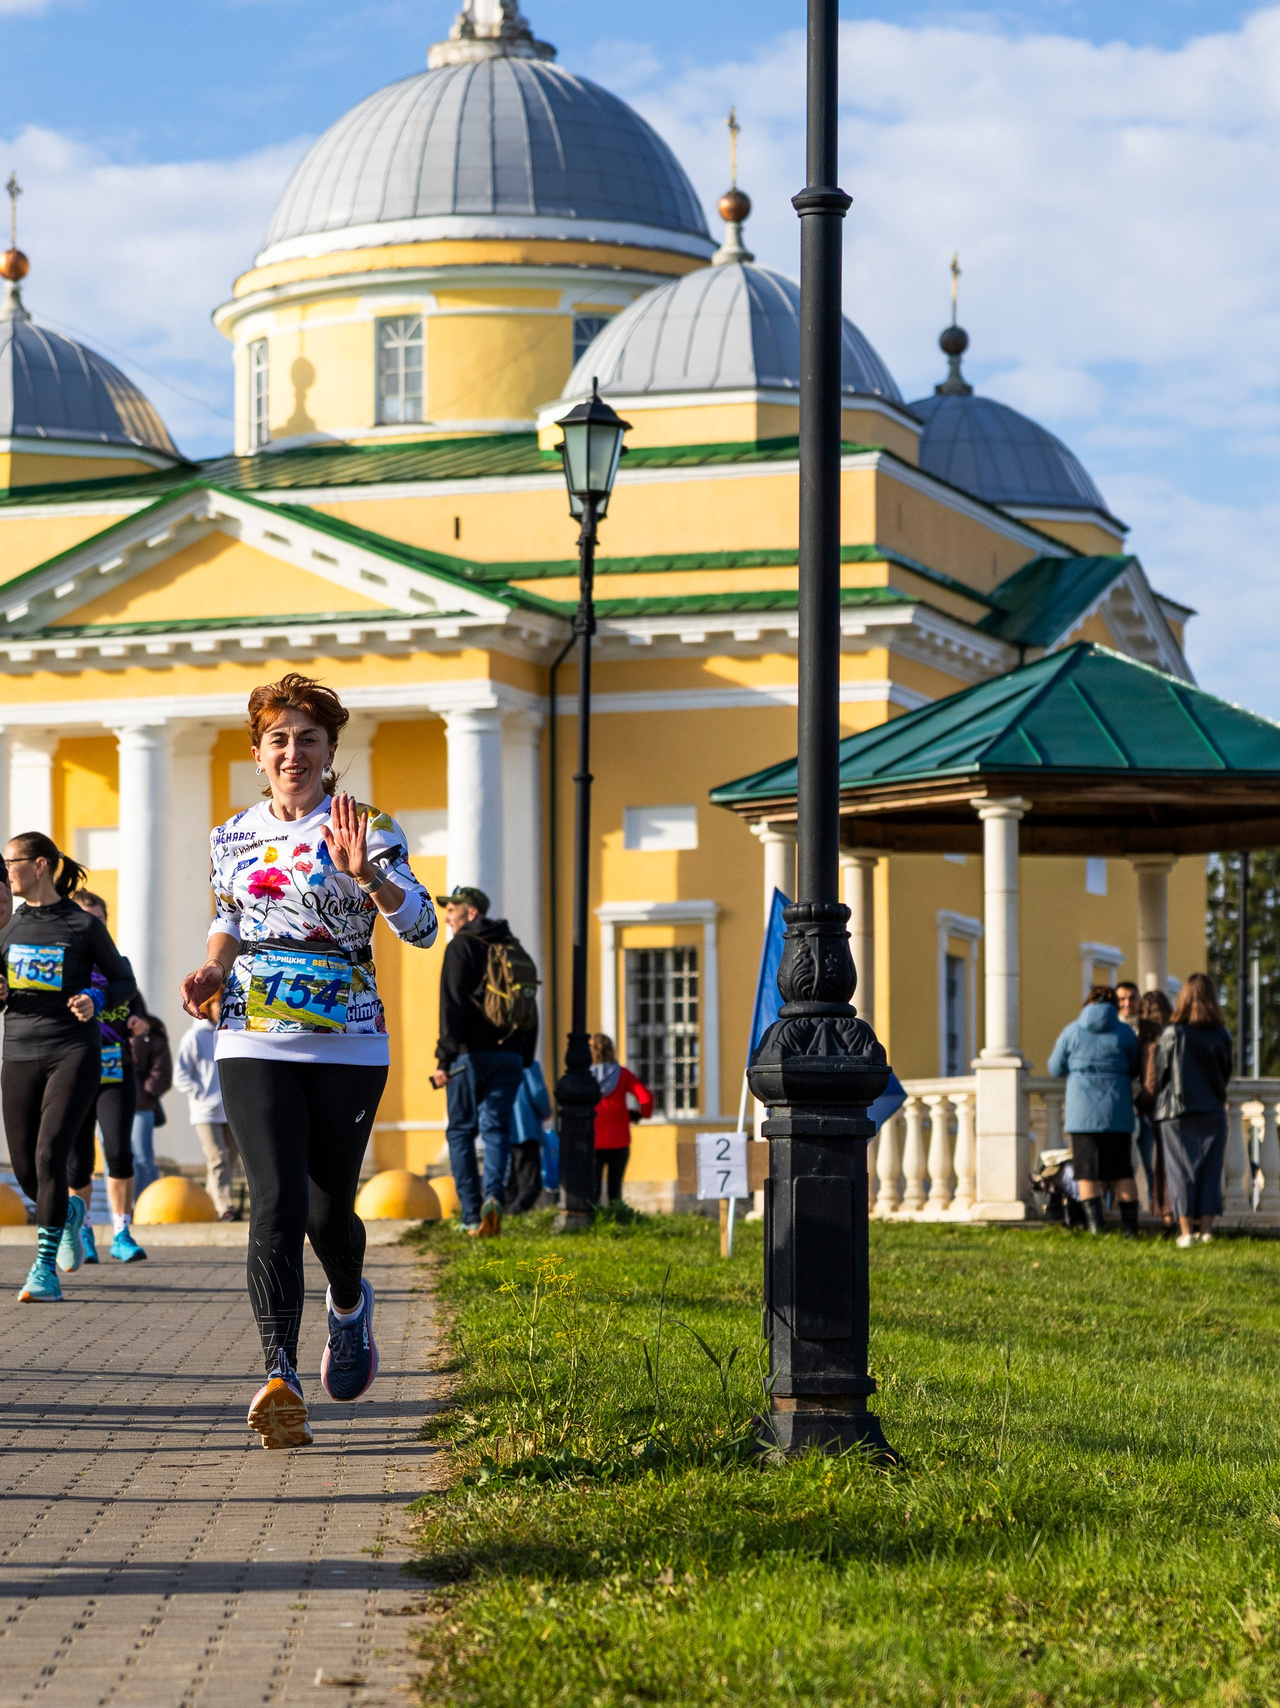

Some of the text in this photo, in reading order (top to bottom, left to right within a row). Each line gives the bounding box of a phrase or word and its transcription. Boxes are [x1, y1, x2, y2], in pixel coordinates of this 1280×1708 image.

[14, 957, 58, 982] 153
[261, 954, 307, 965] СТАРИЦКИЕ
[263, 971, 342, 1013] 154
[716, 1138, 731, 1161] 2
[716, 1170, 731, 1193] 7
